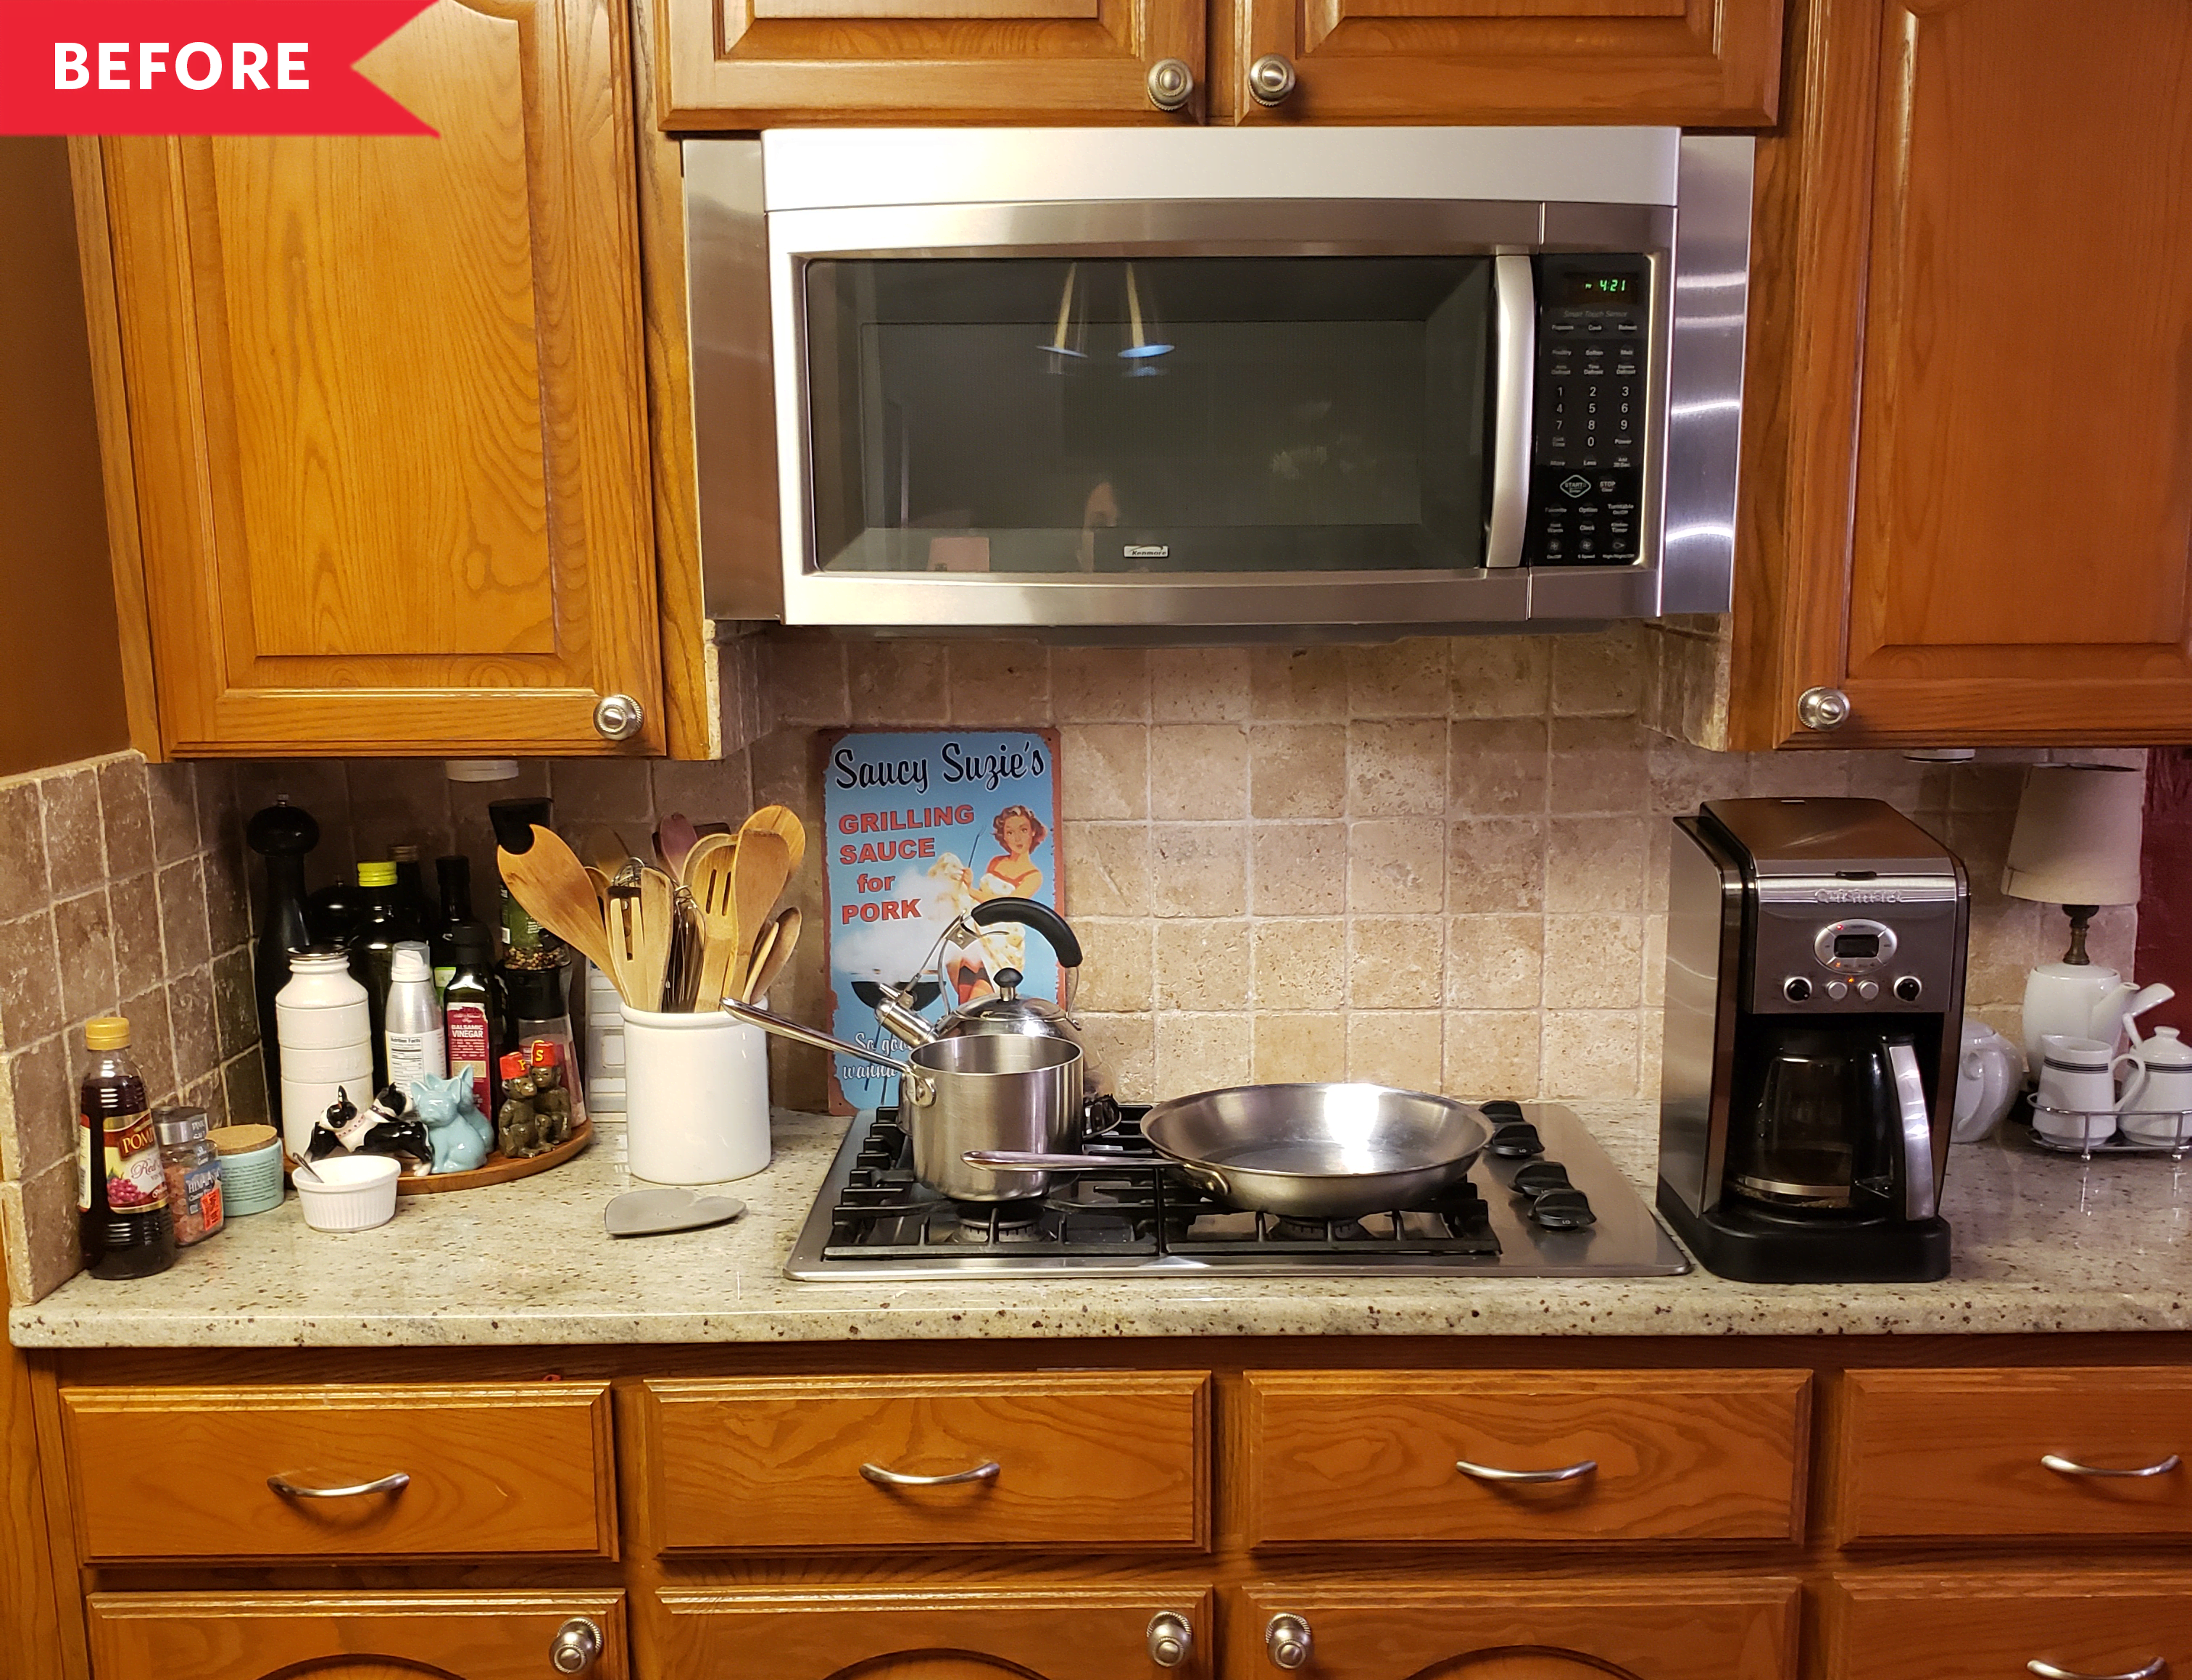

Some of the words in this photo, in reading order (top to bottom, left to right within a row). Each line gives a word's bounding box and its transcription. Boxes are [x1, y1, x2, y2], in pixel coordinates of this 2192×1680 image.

[1600, 280, 1626, 291] 4:21
[1558, 386, 1563, 396] 1
[1590, 386, 1596, 396] 2
[1622, 386, 1629, 396] 3
[1556, 403, 1562, 413] 4
[1589, 403, 1596, 413] 5
[1622, 403, 1628, 413] 6
[1556, 420, 1562, 430] 7
[1588, 420, 1595, 430] 8
[1620, 420, 1627, 430] 9
[1587, 437, 1594, 446] 0
[834, 748, 928, 794] Saucy
[942, 741, 1045, 791] Suzie's
[839, 804, 975, 835] GRILLING
[839, 837, 935, 865] SAUCE
[857, 873, 896, 894] for
[842, 898, 922, 925] PORK
[855, 1031, 878, 1052] So
[535, 1049, 544, 1062] S
[518, 1059, 526, 1071] P
